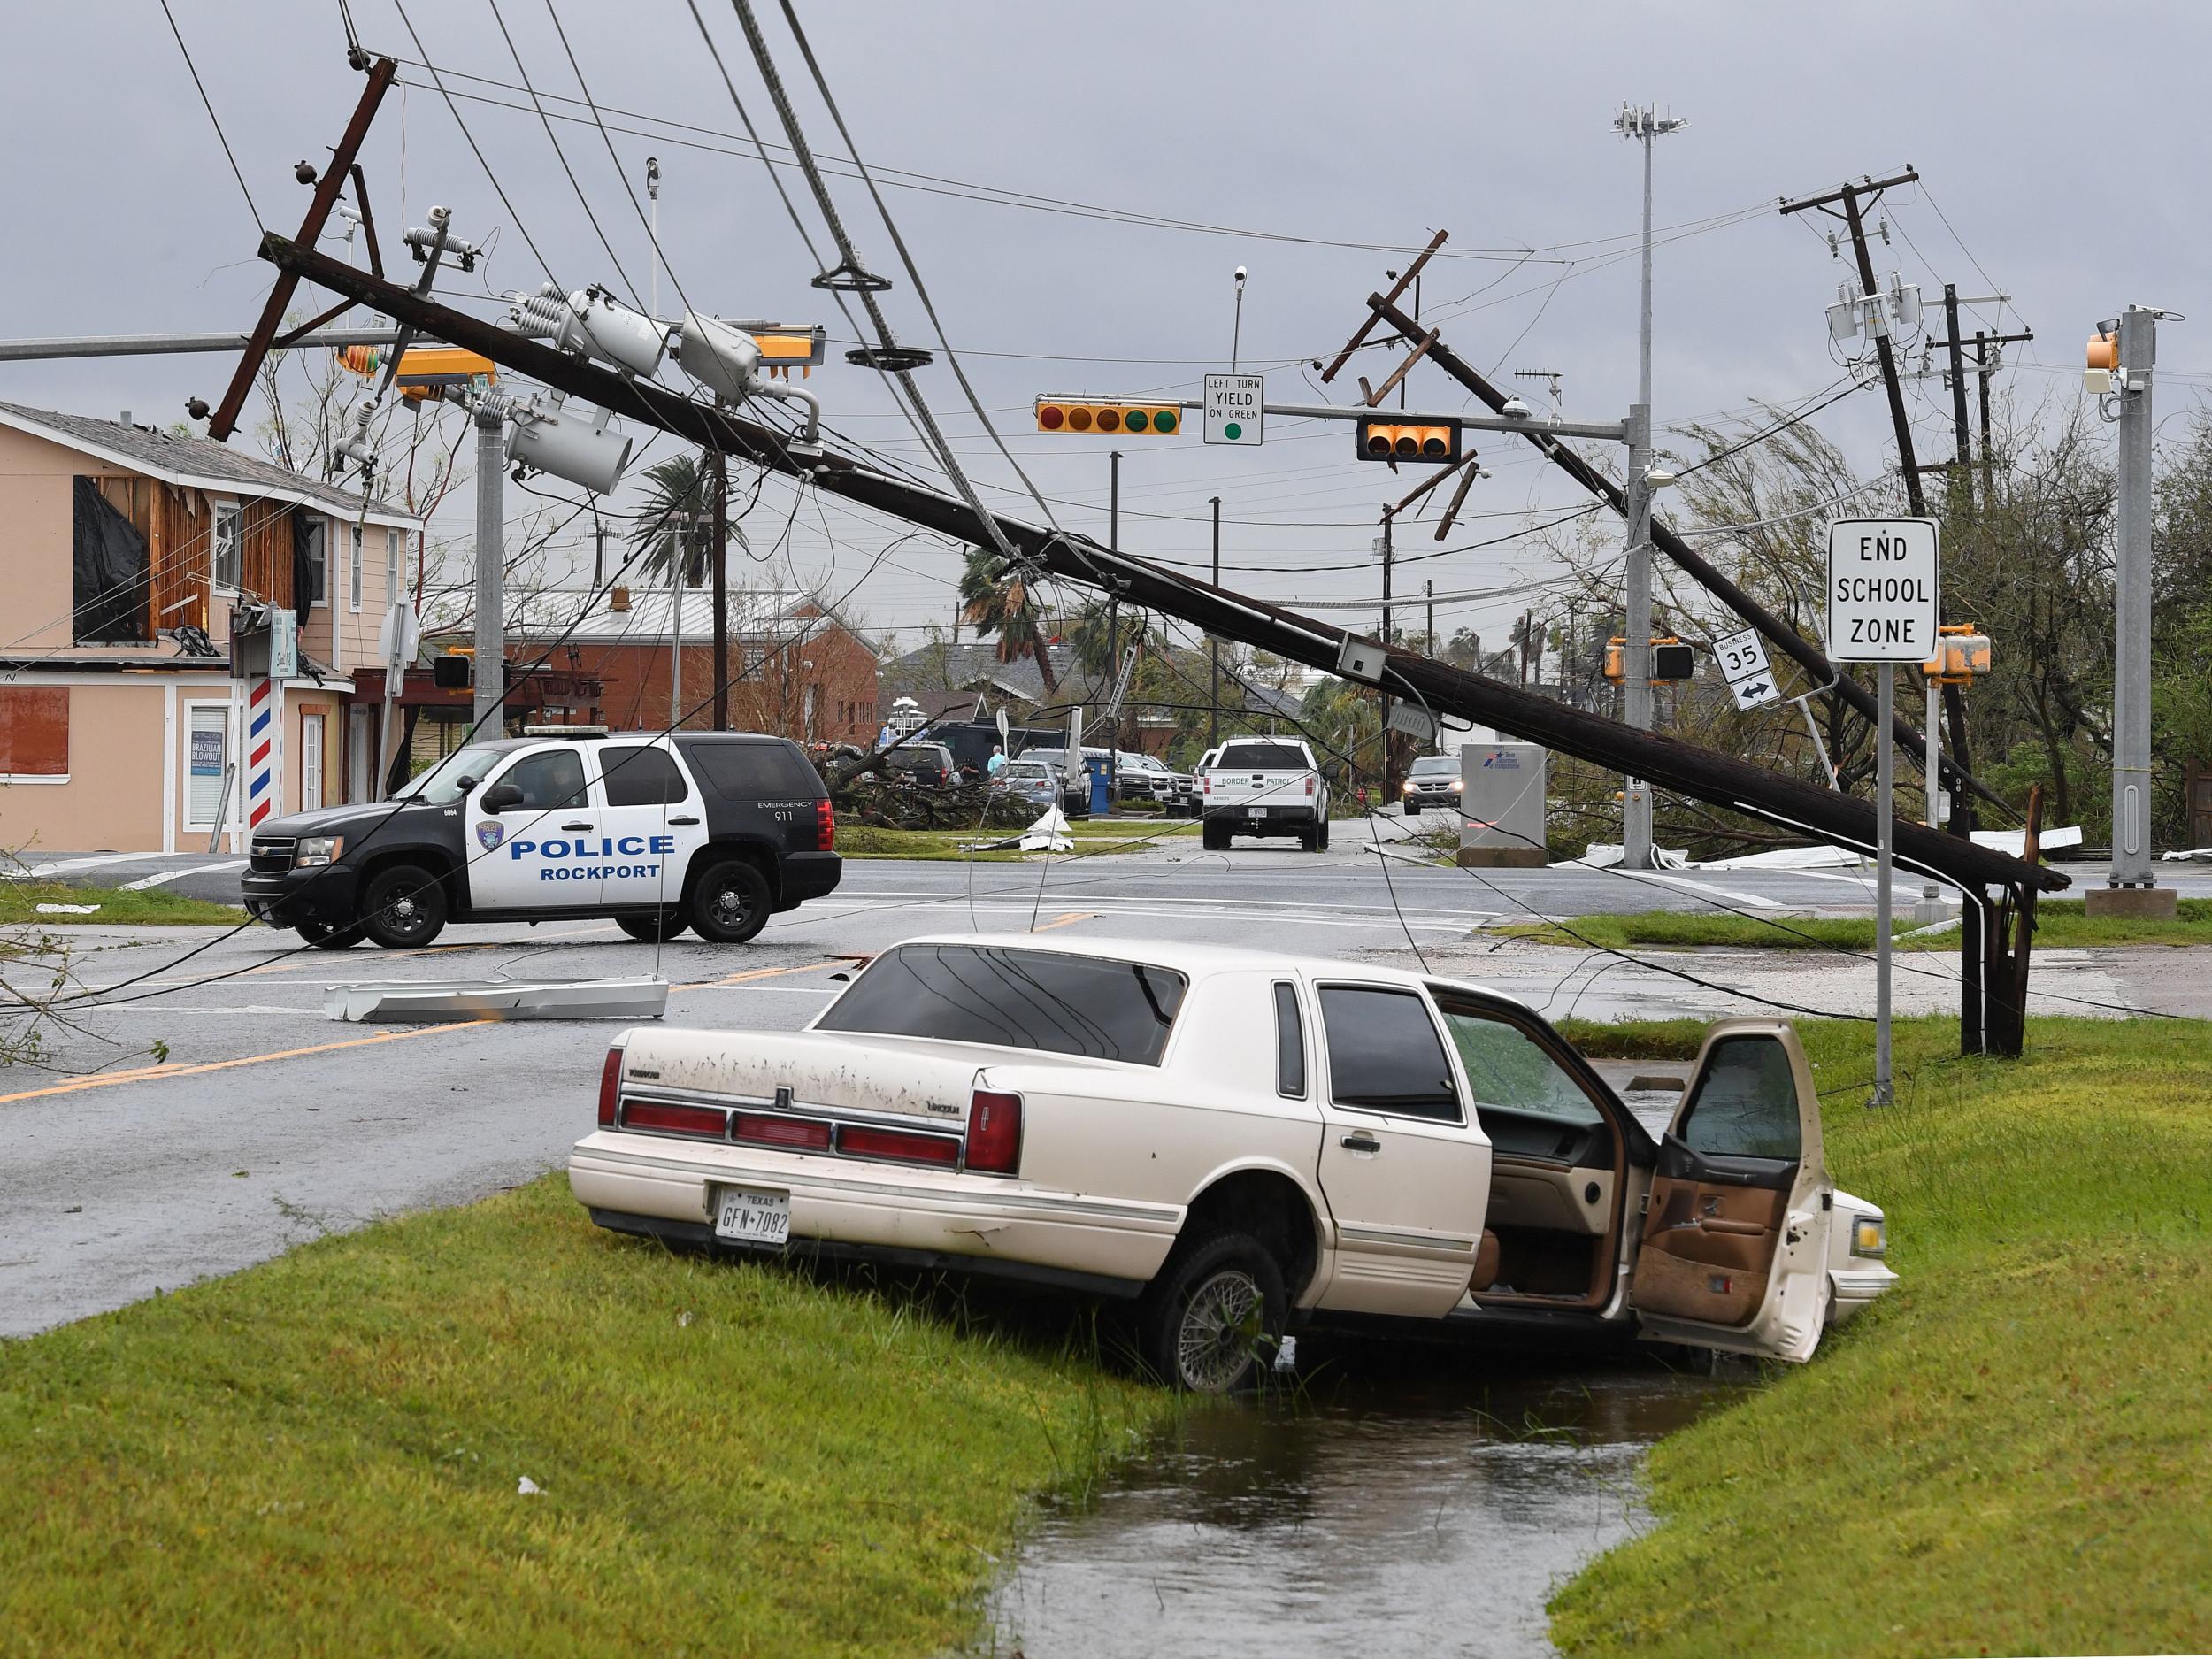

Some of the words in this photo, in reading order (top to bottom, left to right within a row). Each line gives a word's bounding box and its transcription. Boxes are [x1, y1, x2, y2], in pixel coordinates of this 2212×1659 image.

[1208, 379, 1229, 388] LEFT
[1237, 380, 1260, 389] TURN
[1215, 392, 1253, 405] YIELD
[1210, 408, 1222, 418] ON
[1228, 409, 1257, 419] GREEN
[1860, 536, 1907, 561] END
[1836, 577, 1929, 603] SCHOOL
[1850, 618, 1915, 643] ZONE
[1718, 633, 1752, 651] BUSINESS
[1726, 644, 1757, 671] 35
[192, 742, 221, 753] BRAZILIAN
[192, 751, 220, 762] BLOWOUT
[774, 811, 793, 822] 911
[511, 835, 675, 861] POLICE
[541, 864, 660, 881] ROCKPORT
[747, 1194, 775, 1207] TEXAS
